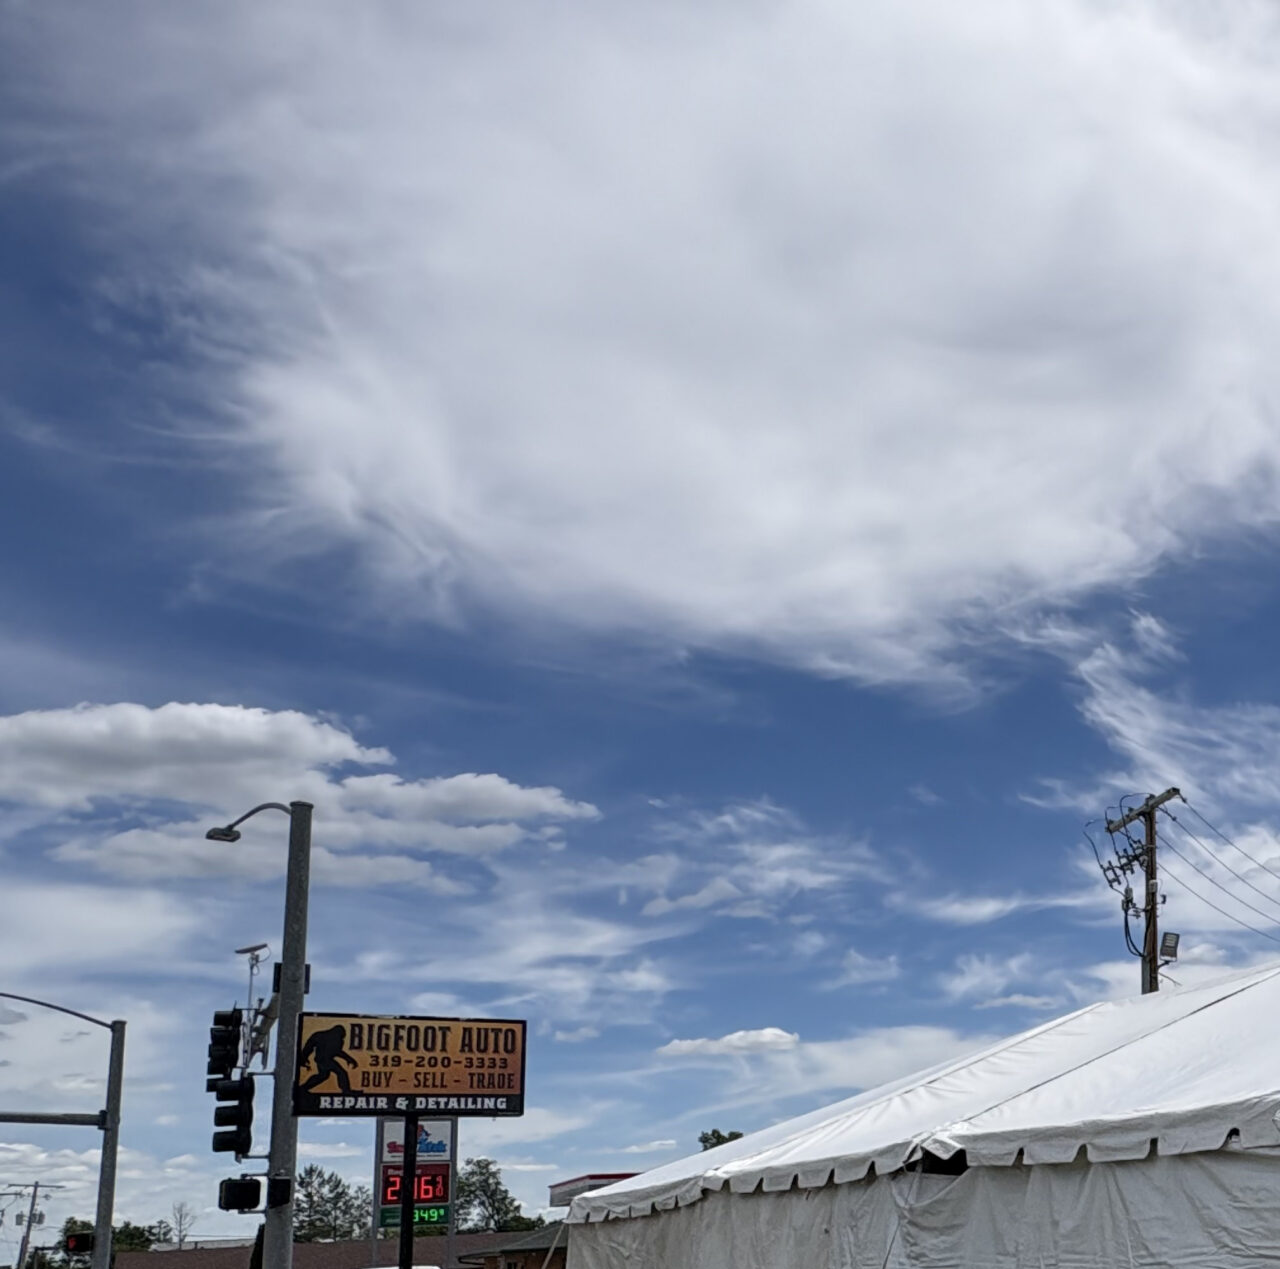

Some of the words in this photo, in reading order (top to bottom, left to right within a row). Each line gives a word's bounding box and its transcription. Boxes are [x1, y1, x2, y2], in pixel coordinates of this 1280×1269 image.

[349, 1023, 452, 1054] BIGFOOT
[459, 1027, 517, 1055] AUTO
[369, 1055, 508, 1069] 319-200-3333
[360, 1071, 394, 1088] BUY
[413, 1071, 448, 1088] SELL
[468, 1072, 515, 1089] TRADE
[319, 1096, 388, 1109] REPAIR
[395, 1096, 409, 1110] &
[415, 1097, 507, 1110] DETAILING
